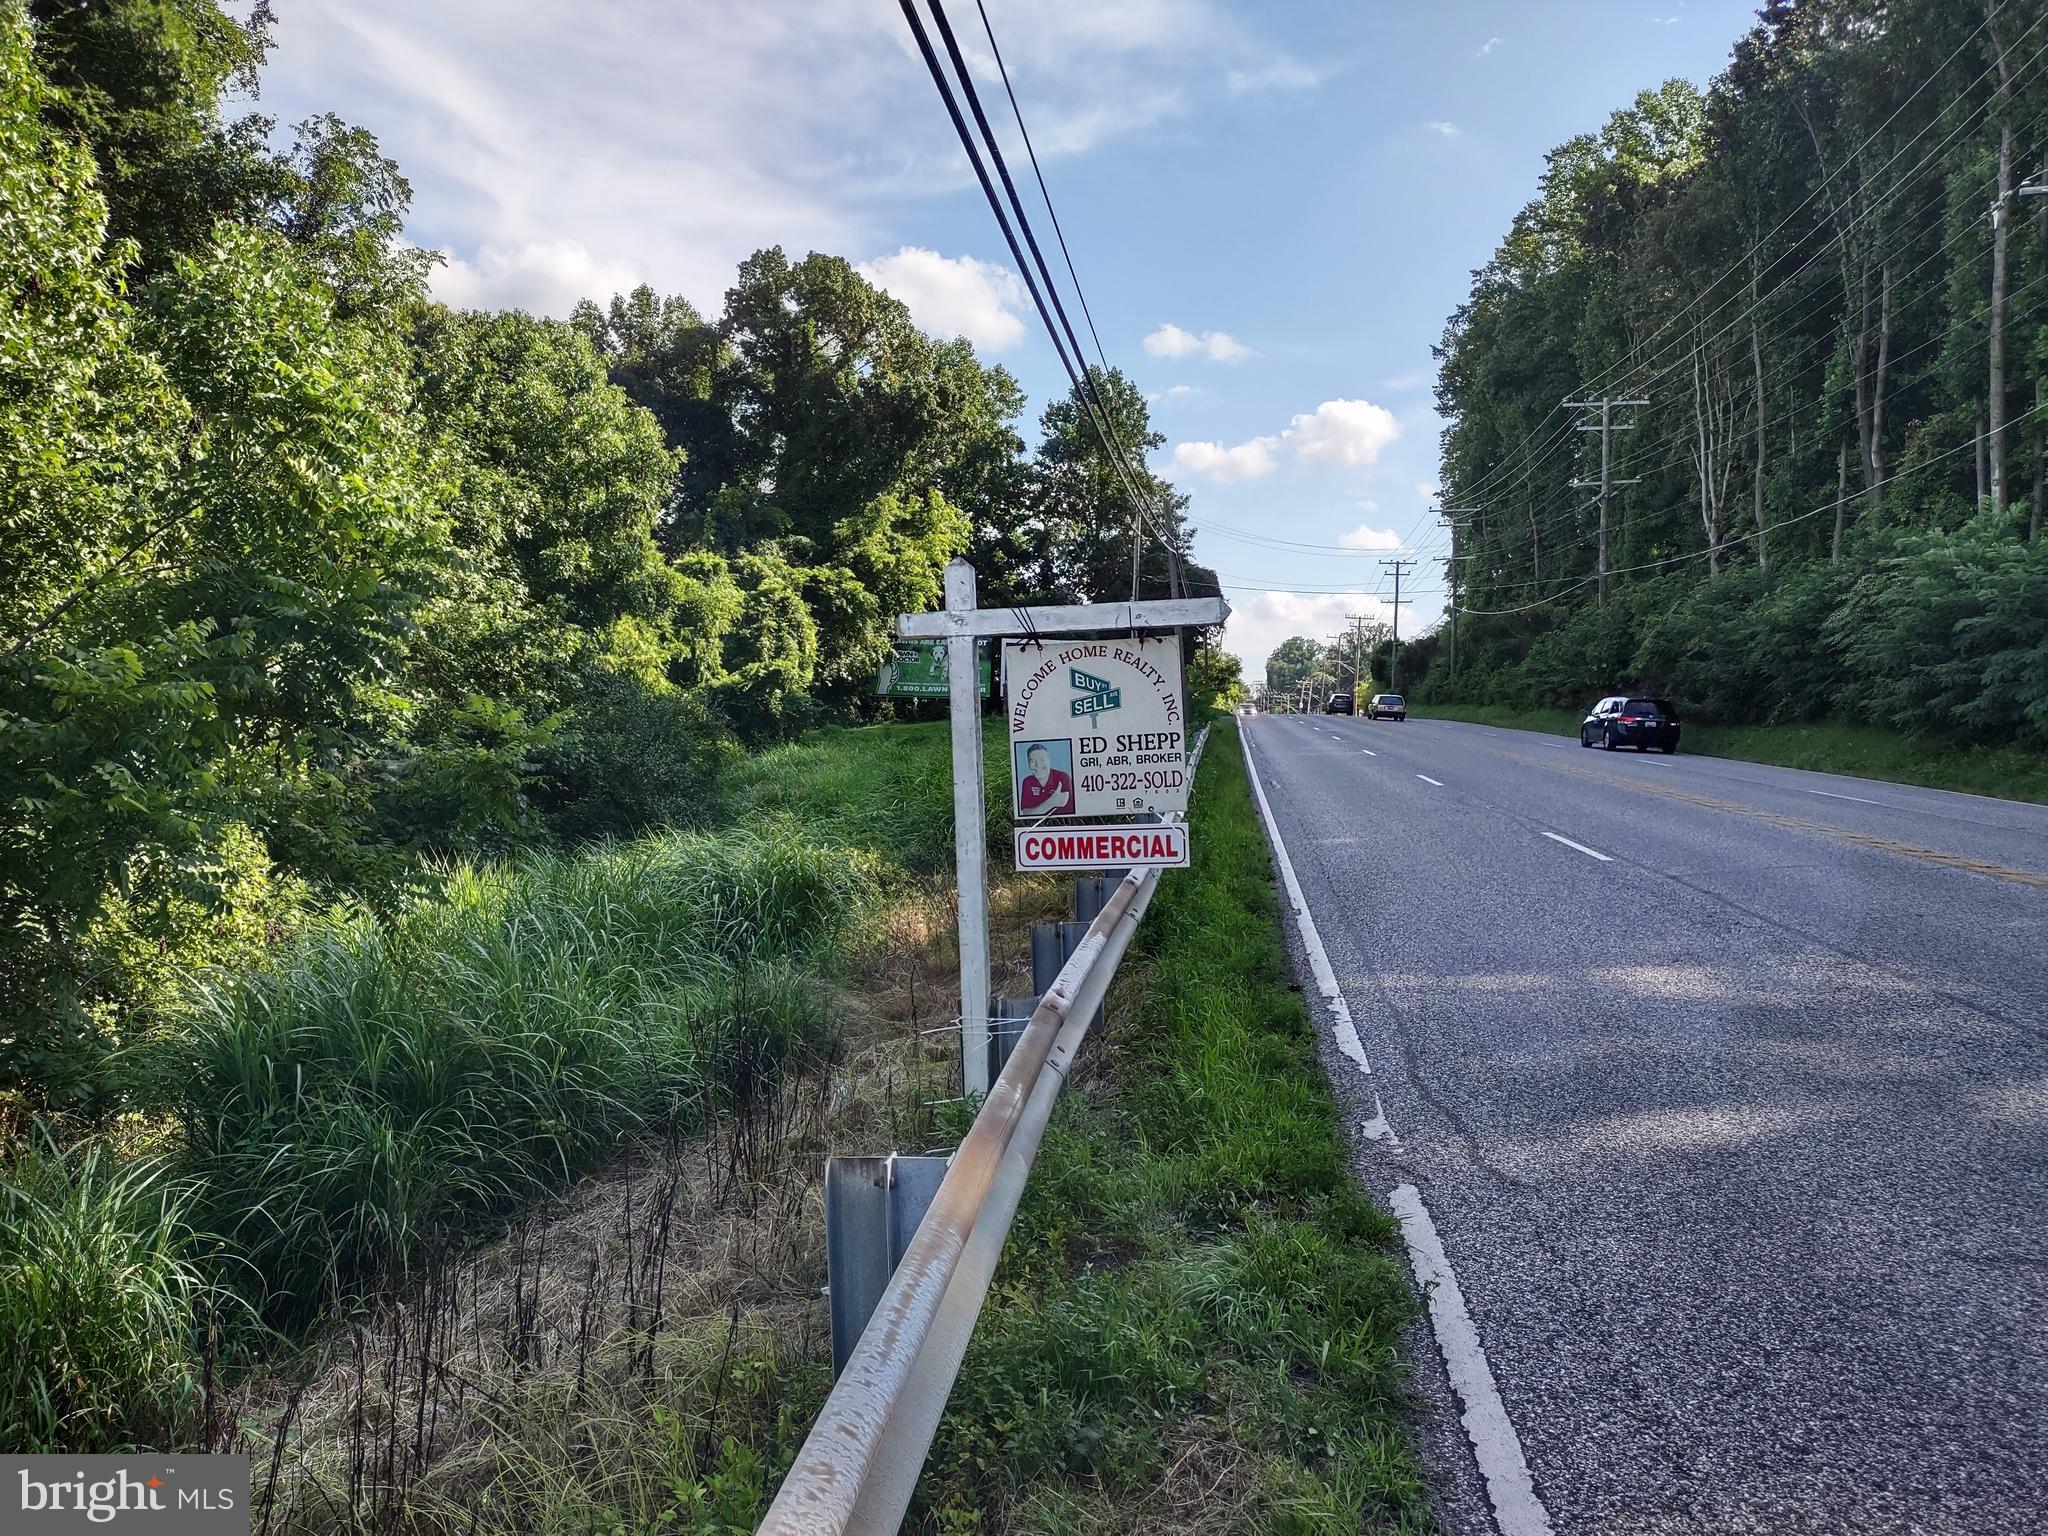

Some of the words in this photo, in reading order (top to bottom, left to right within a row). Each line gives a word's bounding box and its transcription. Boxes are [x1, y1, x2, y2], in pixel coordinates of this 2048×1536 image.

[1013, 660, 1057, 733] WELCOME
[1058, 645, 1108, 664] HOME
[1113, 648, 1166, 692] REALTY,
[1162, 693, 1180, 726] INC.
[1074, 673, 1101, 691] BUY
[1074, 694, 1115, 714] SELL
[1079, 736, 1107, 754] ED
[1116, 732, 1181, 752] SHEPP
[1080, 757, 1102, 768] GRI,
[1106, 755, 1131, 766] ABR,
[1136, 752, 1182, 764] BROKER
[1081, 770, 1183, 792] 410-322-SOLD
[1025, 834, 1178, 861] COMMERCIAL
